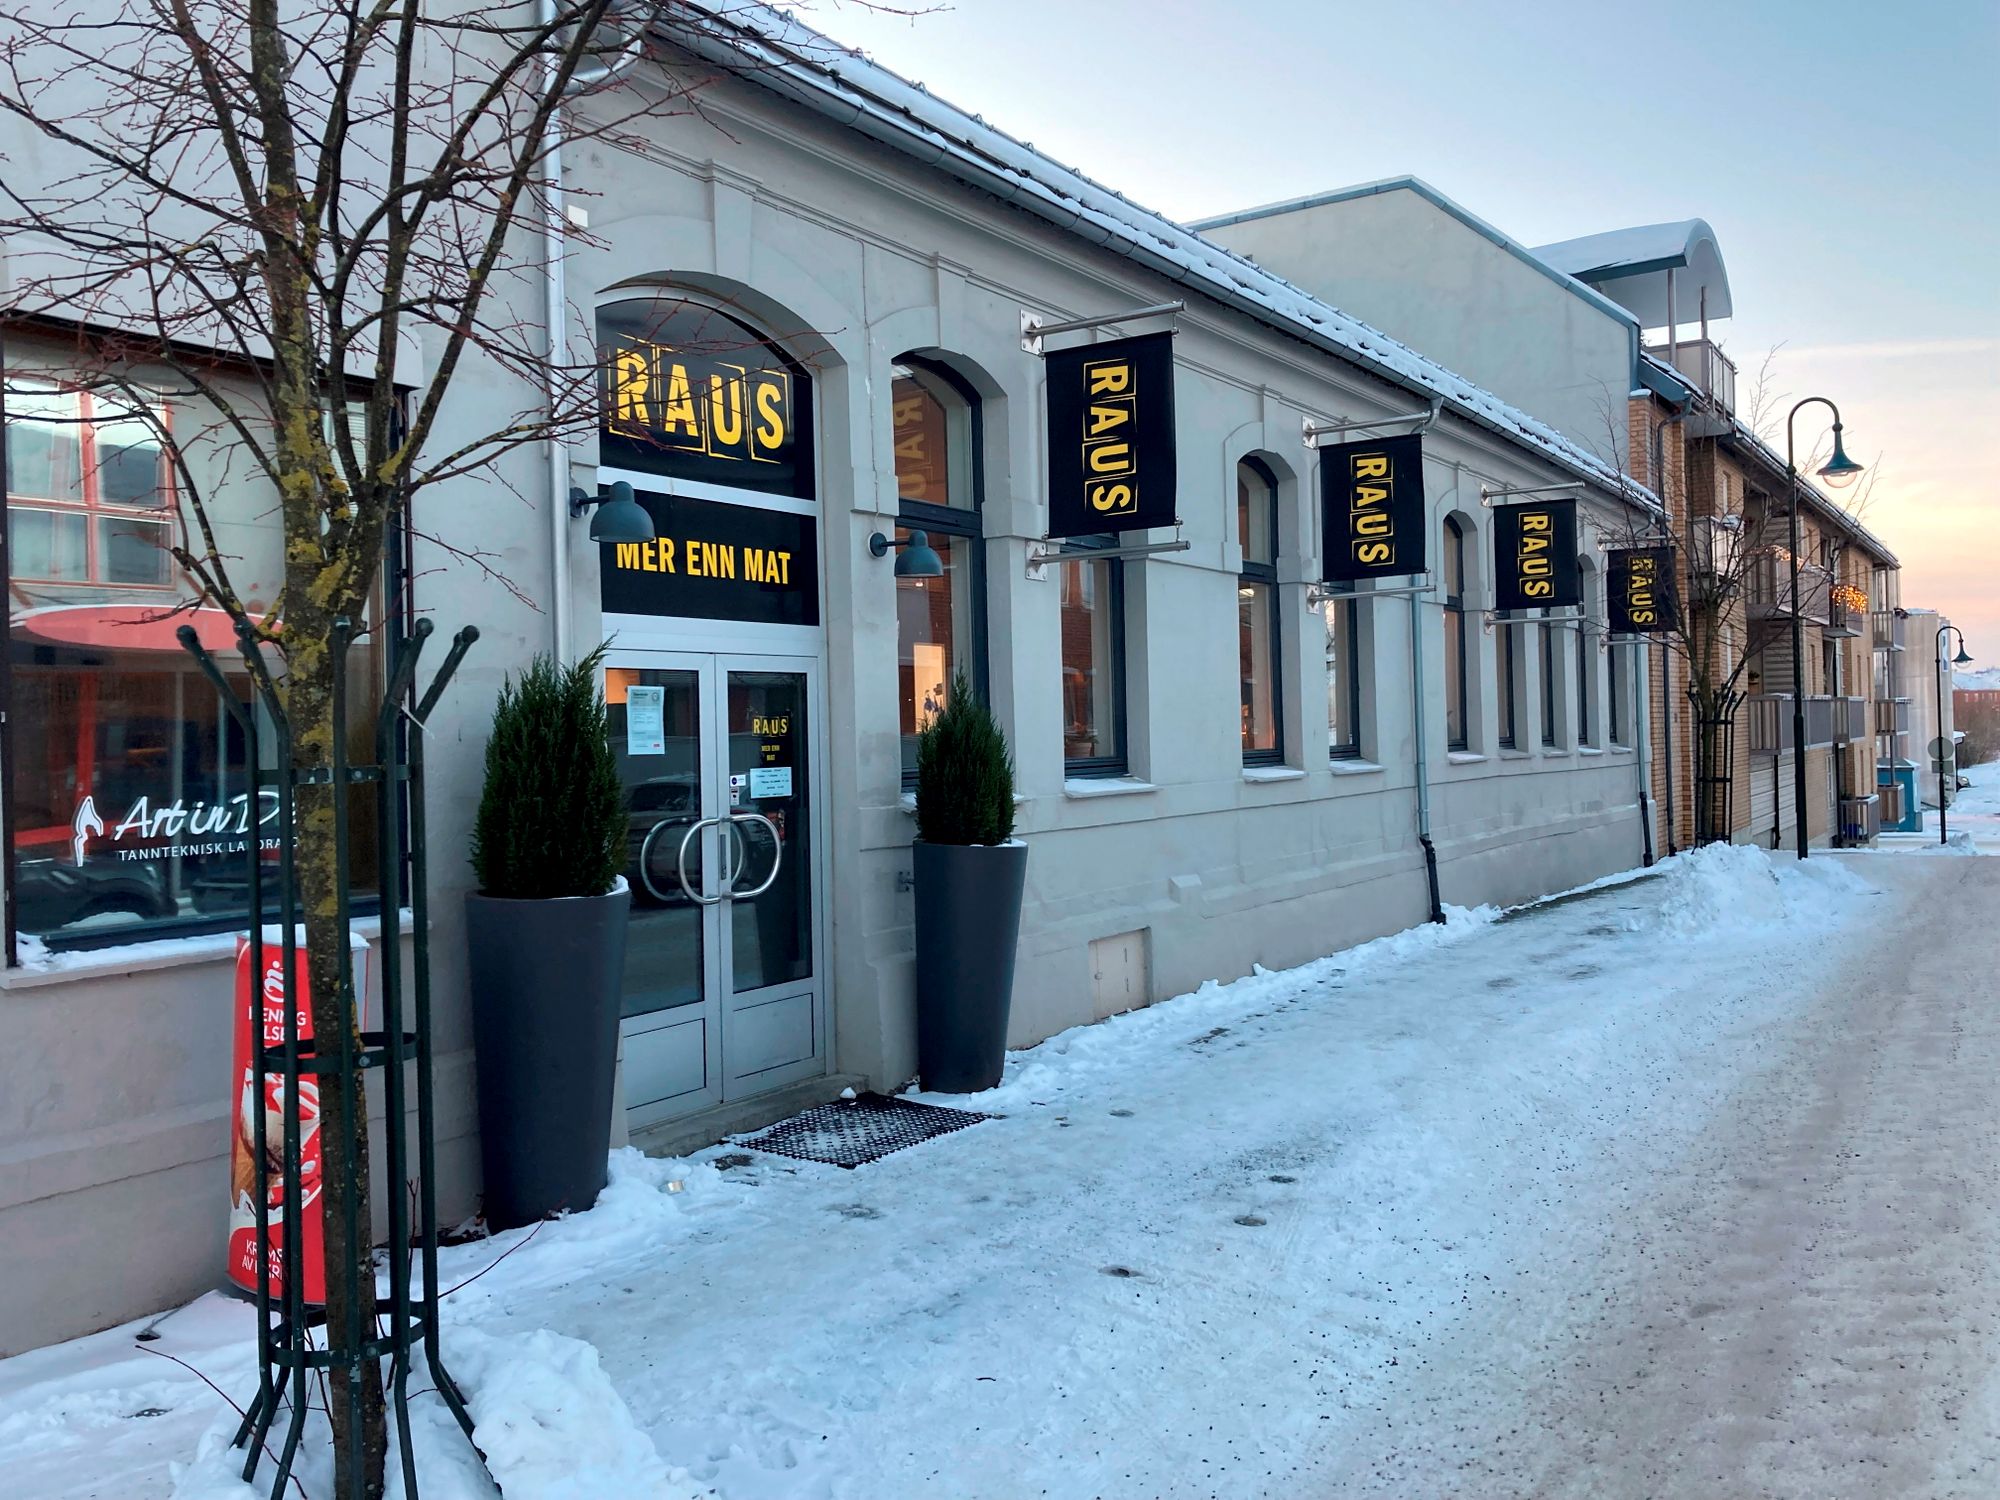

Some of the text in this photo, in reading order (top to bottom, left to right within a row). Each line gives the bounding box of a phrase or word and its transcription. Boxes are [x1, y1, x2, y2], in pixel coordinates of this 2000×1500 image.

[617, 348, 784, 450] RAUS
[1090, 365, 1131, 511] RAUS
[1356, 457, 1389, 563] RAUS
[616, 537, 791, 585] MER ENN MAT
[1523, 515, 1549, 596] RAUS
[1631, 557, 1654, 623] RAUS
[753, 718, 787, 734] RAUS
[114, 795, 187, 841] Art
[189, 801, 232, 835] in
[119, 841, 223, 861] TANNTEKNISK
